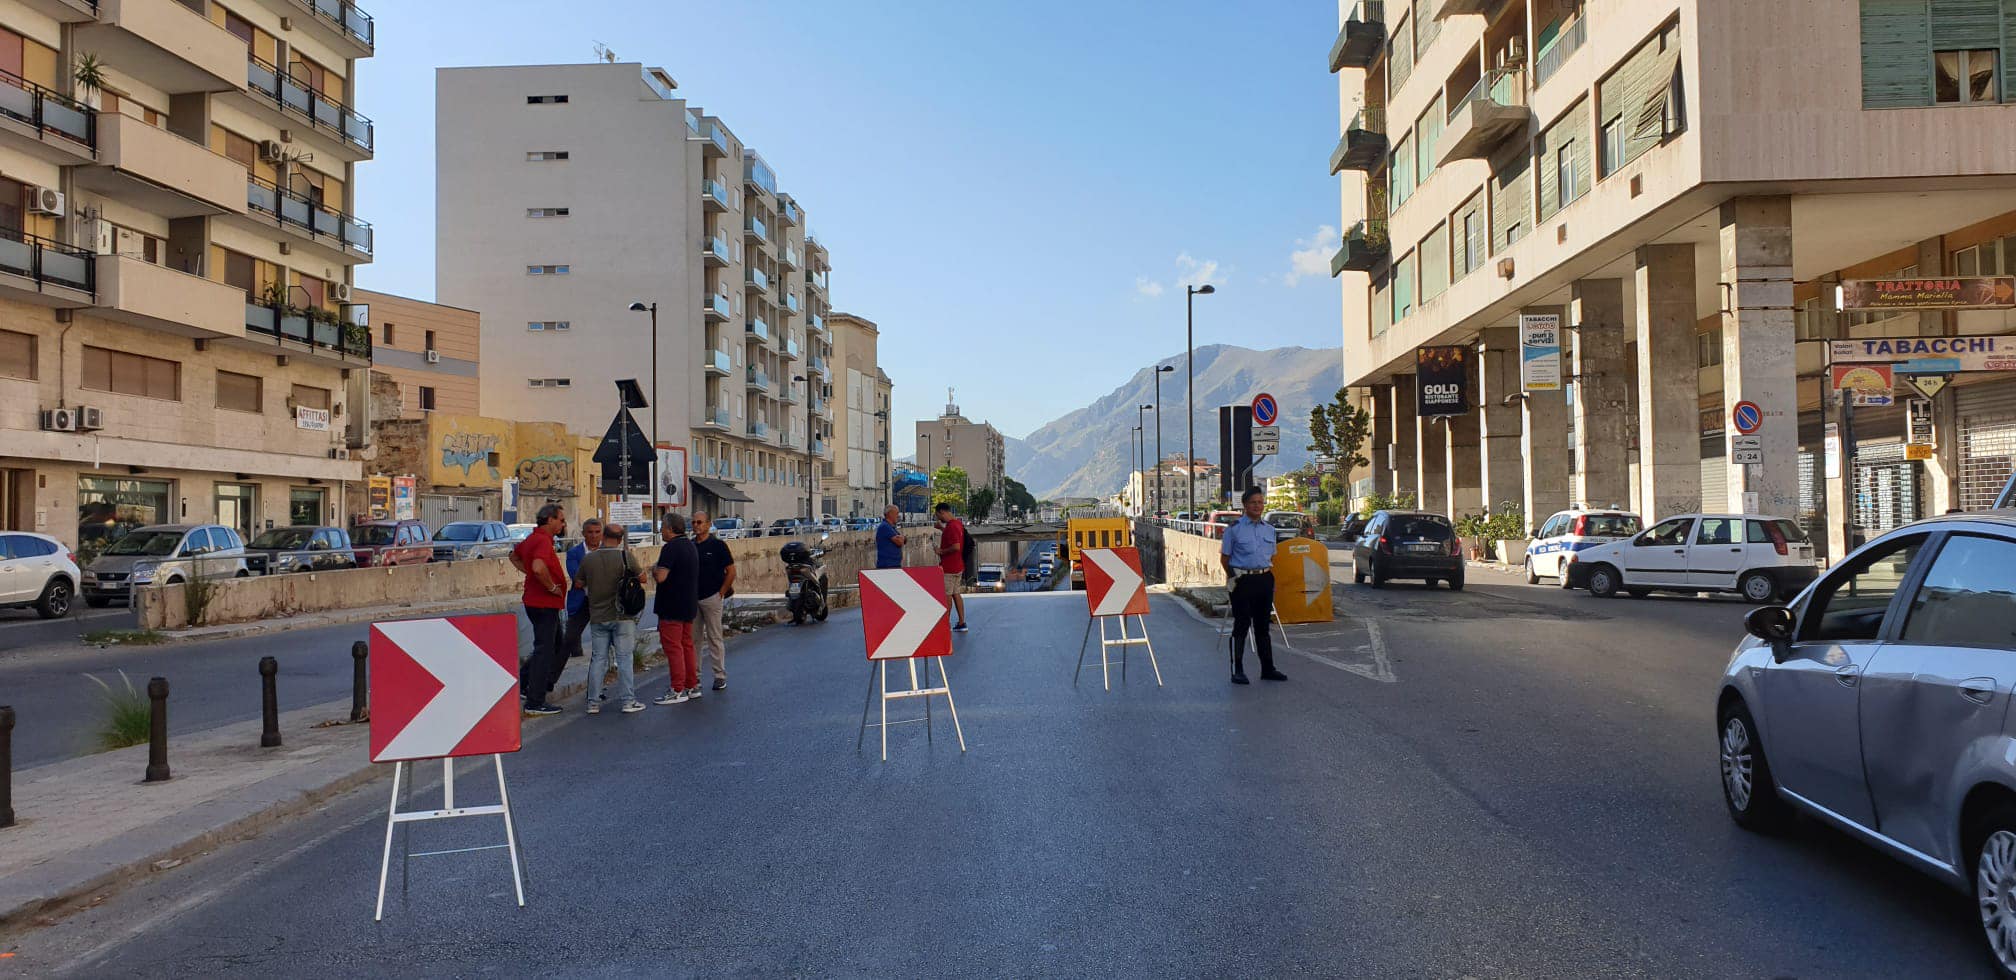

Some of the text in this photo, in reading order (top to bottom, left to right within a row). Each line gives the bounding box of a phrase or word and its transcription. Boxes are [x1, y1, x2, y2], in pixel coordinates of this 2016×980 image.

[1875, 280, 1961, 292] TRATTORIA
[1880, 292, 1913, 300] Mamma
[1862, 338, 1994, 355] TABACCHI
[1424, 384, 1459, 394] GOLD
[298, 408, 328, 422] AFFITTASI
